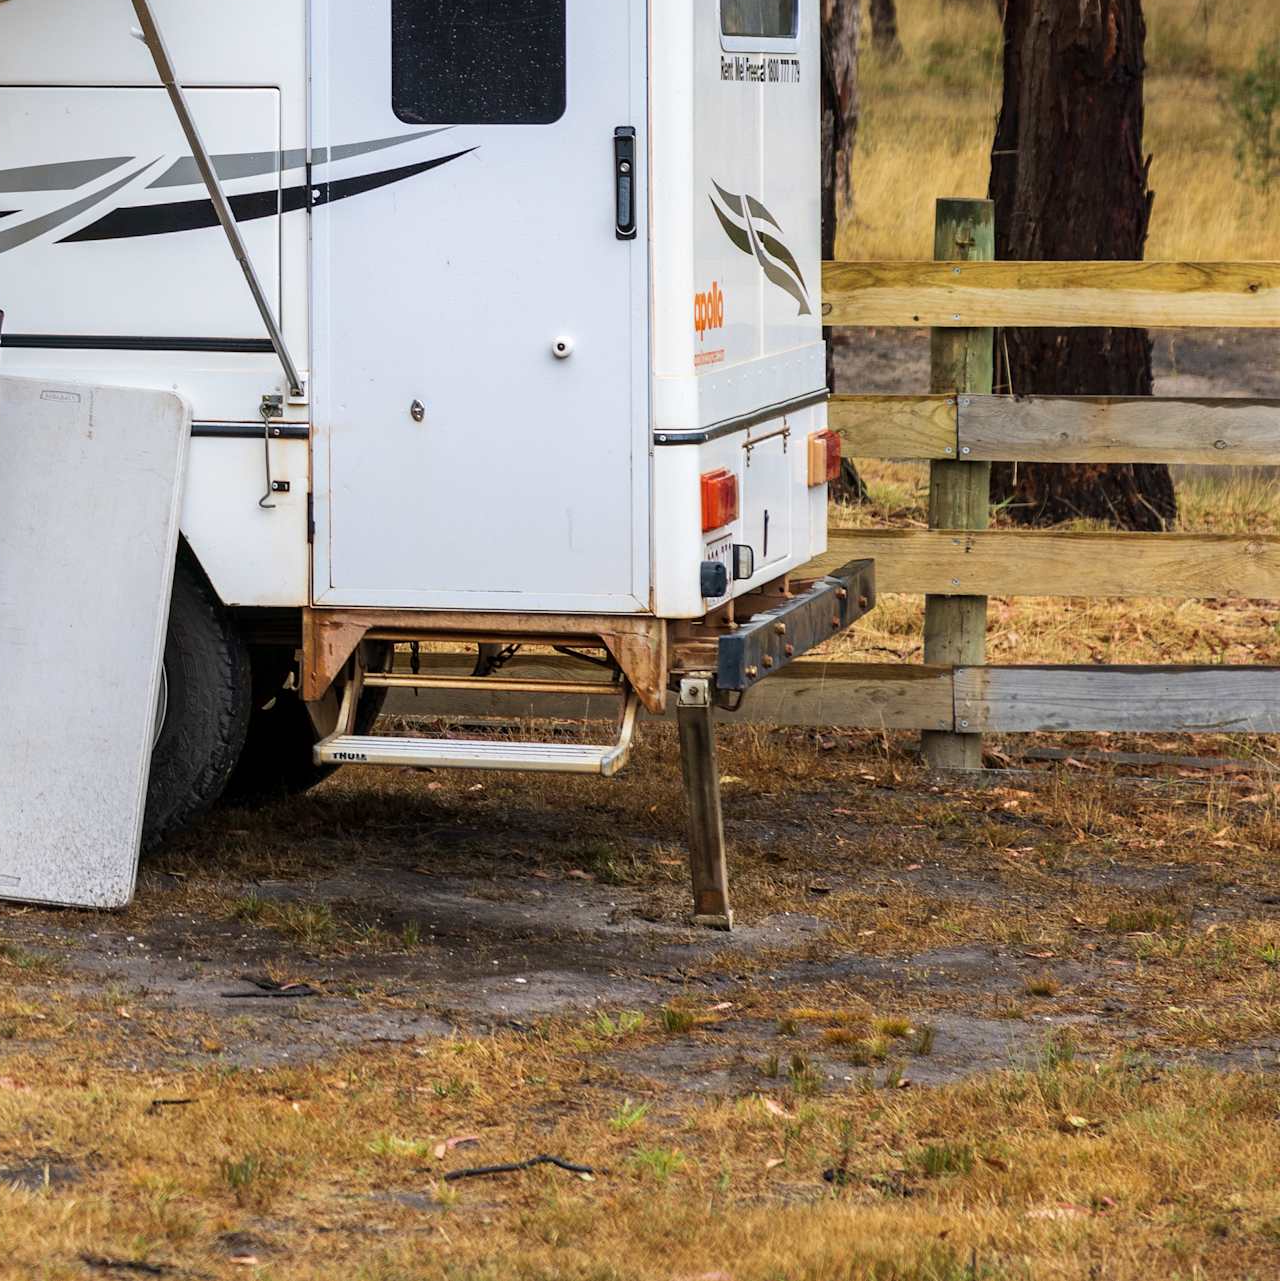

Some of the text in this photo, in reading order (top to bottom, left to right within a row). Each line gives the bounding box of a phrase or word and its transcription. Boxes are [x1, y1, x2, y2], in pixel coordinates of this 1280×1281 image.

[721, 56, 734, 81] Rent
[768, 59, 779, 82] 1800
[694, 280, 724, 341] apollo
